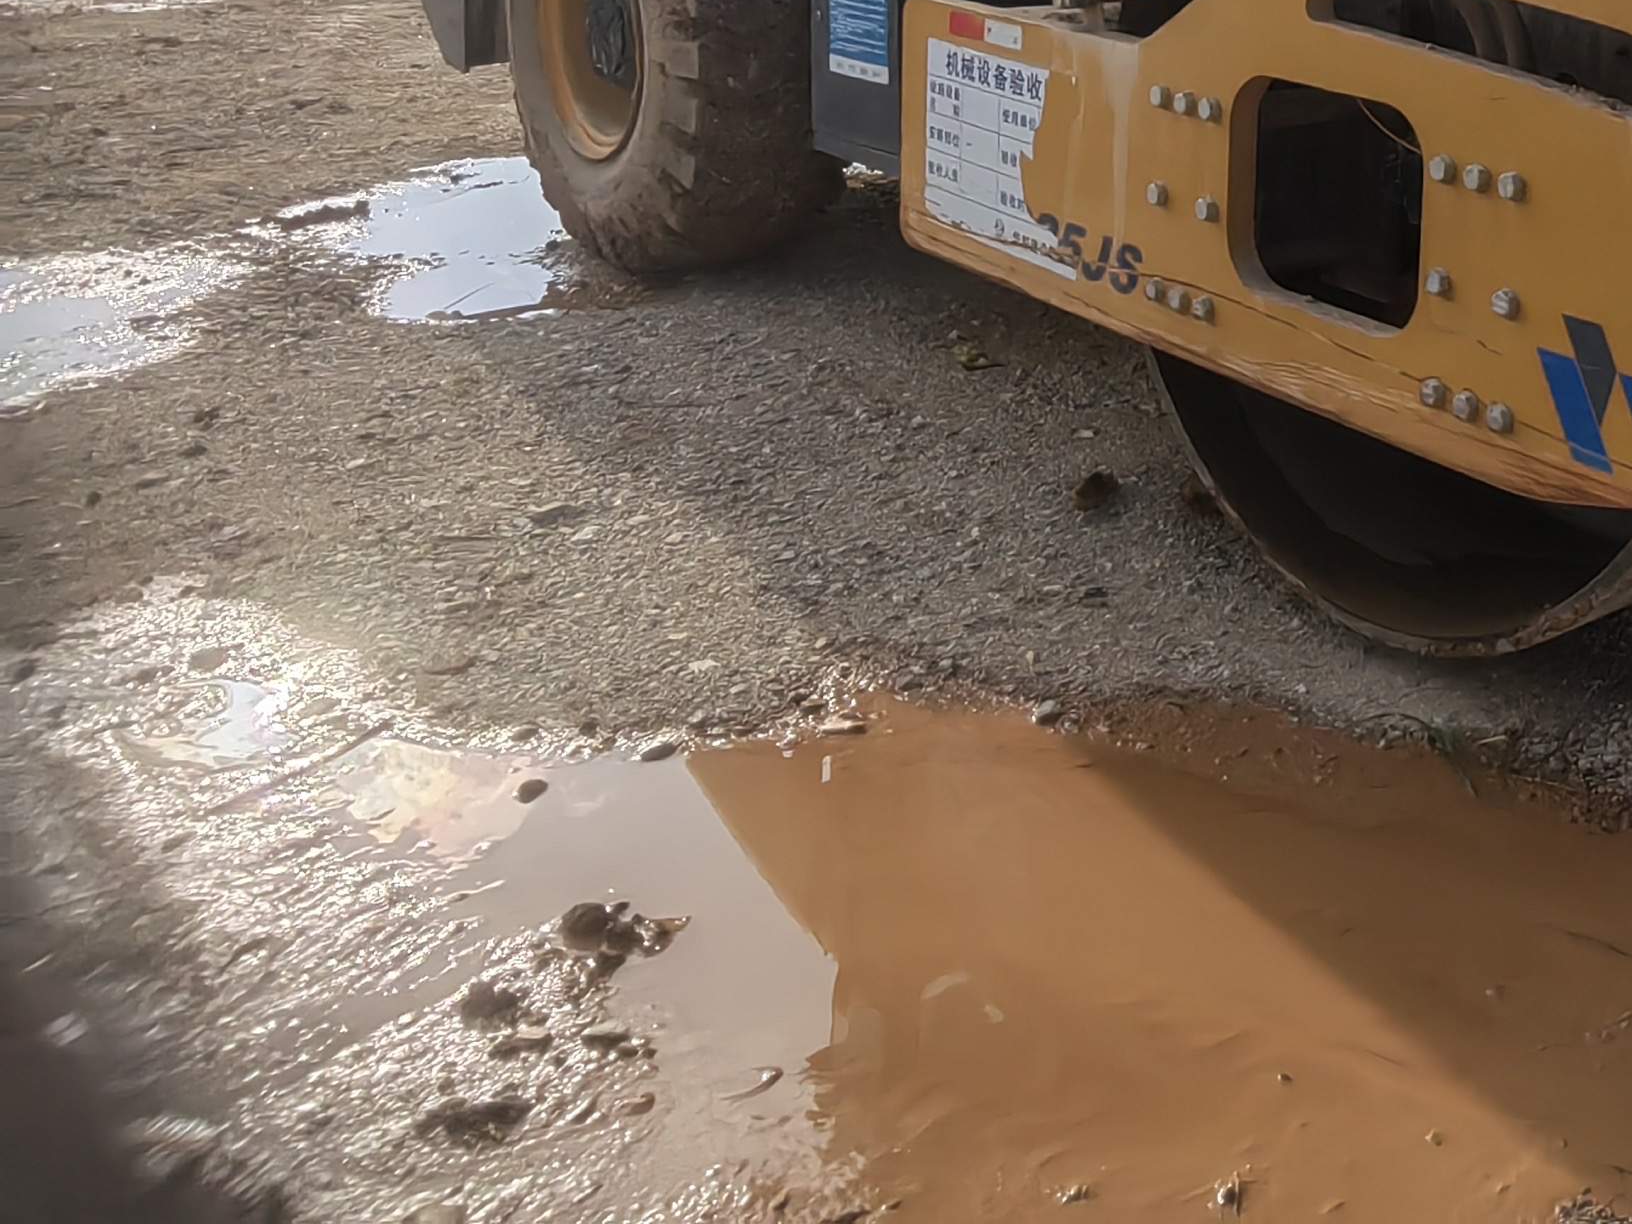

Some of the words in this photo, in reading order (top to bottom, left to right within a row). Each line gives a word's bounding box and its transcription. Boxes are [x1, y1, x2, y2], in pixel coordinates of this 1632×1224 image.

[945, 49, 1042, 101] 机械设备验收
